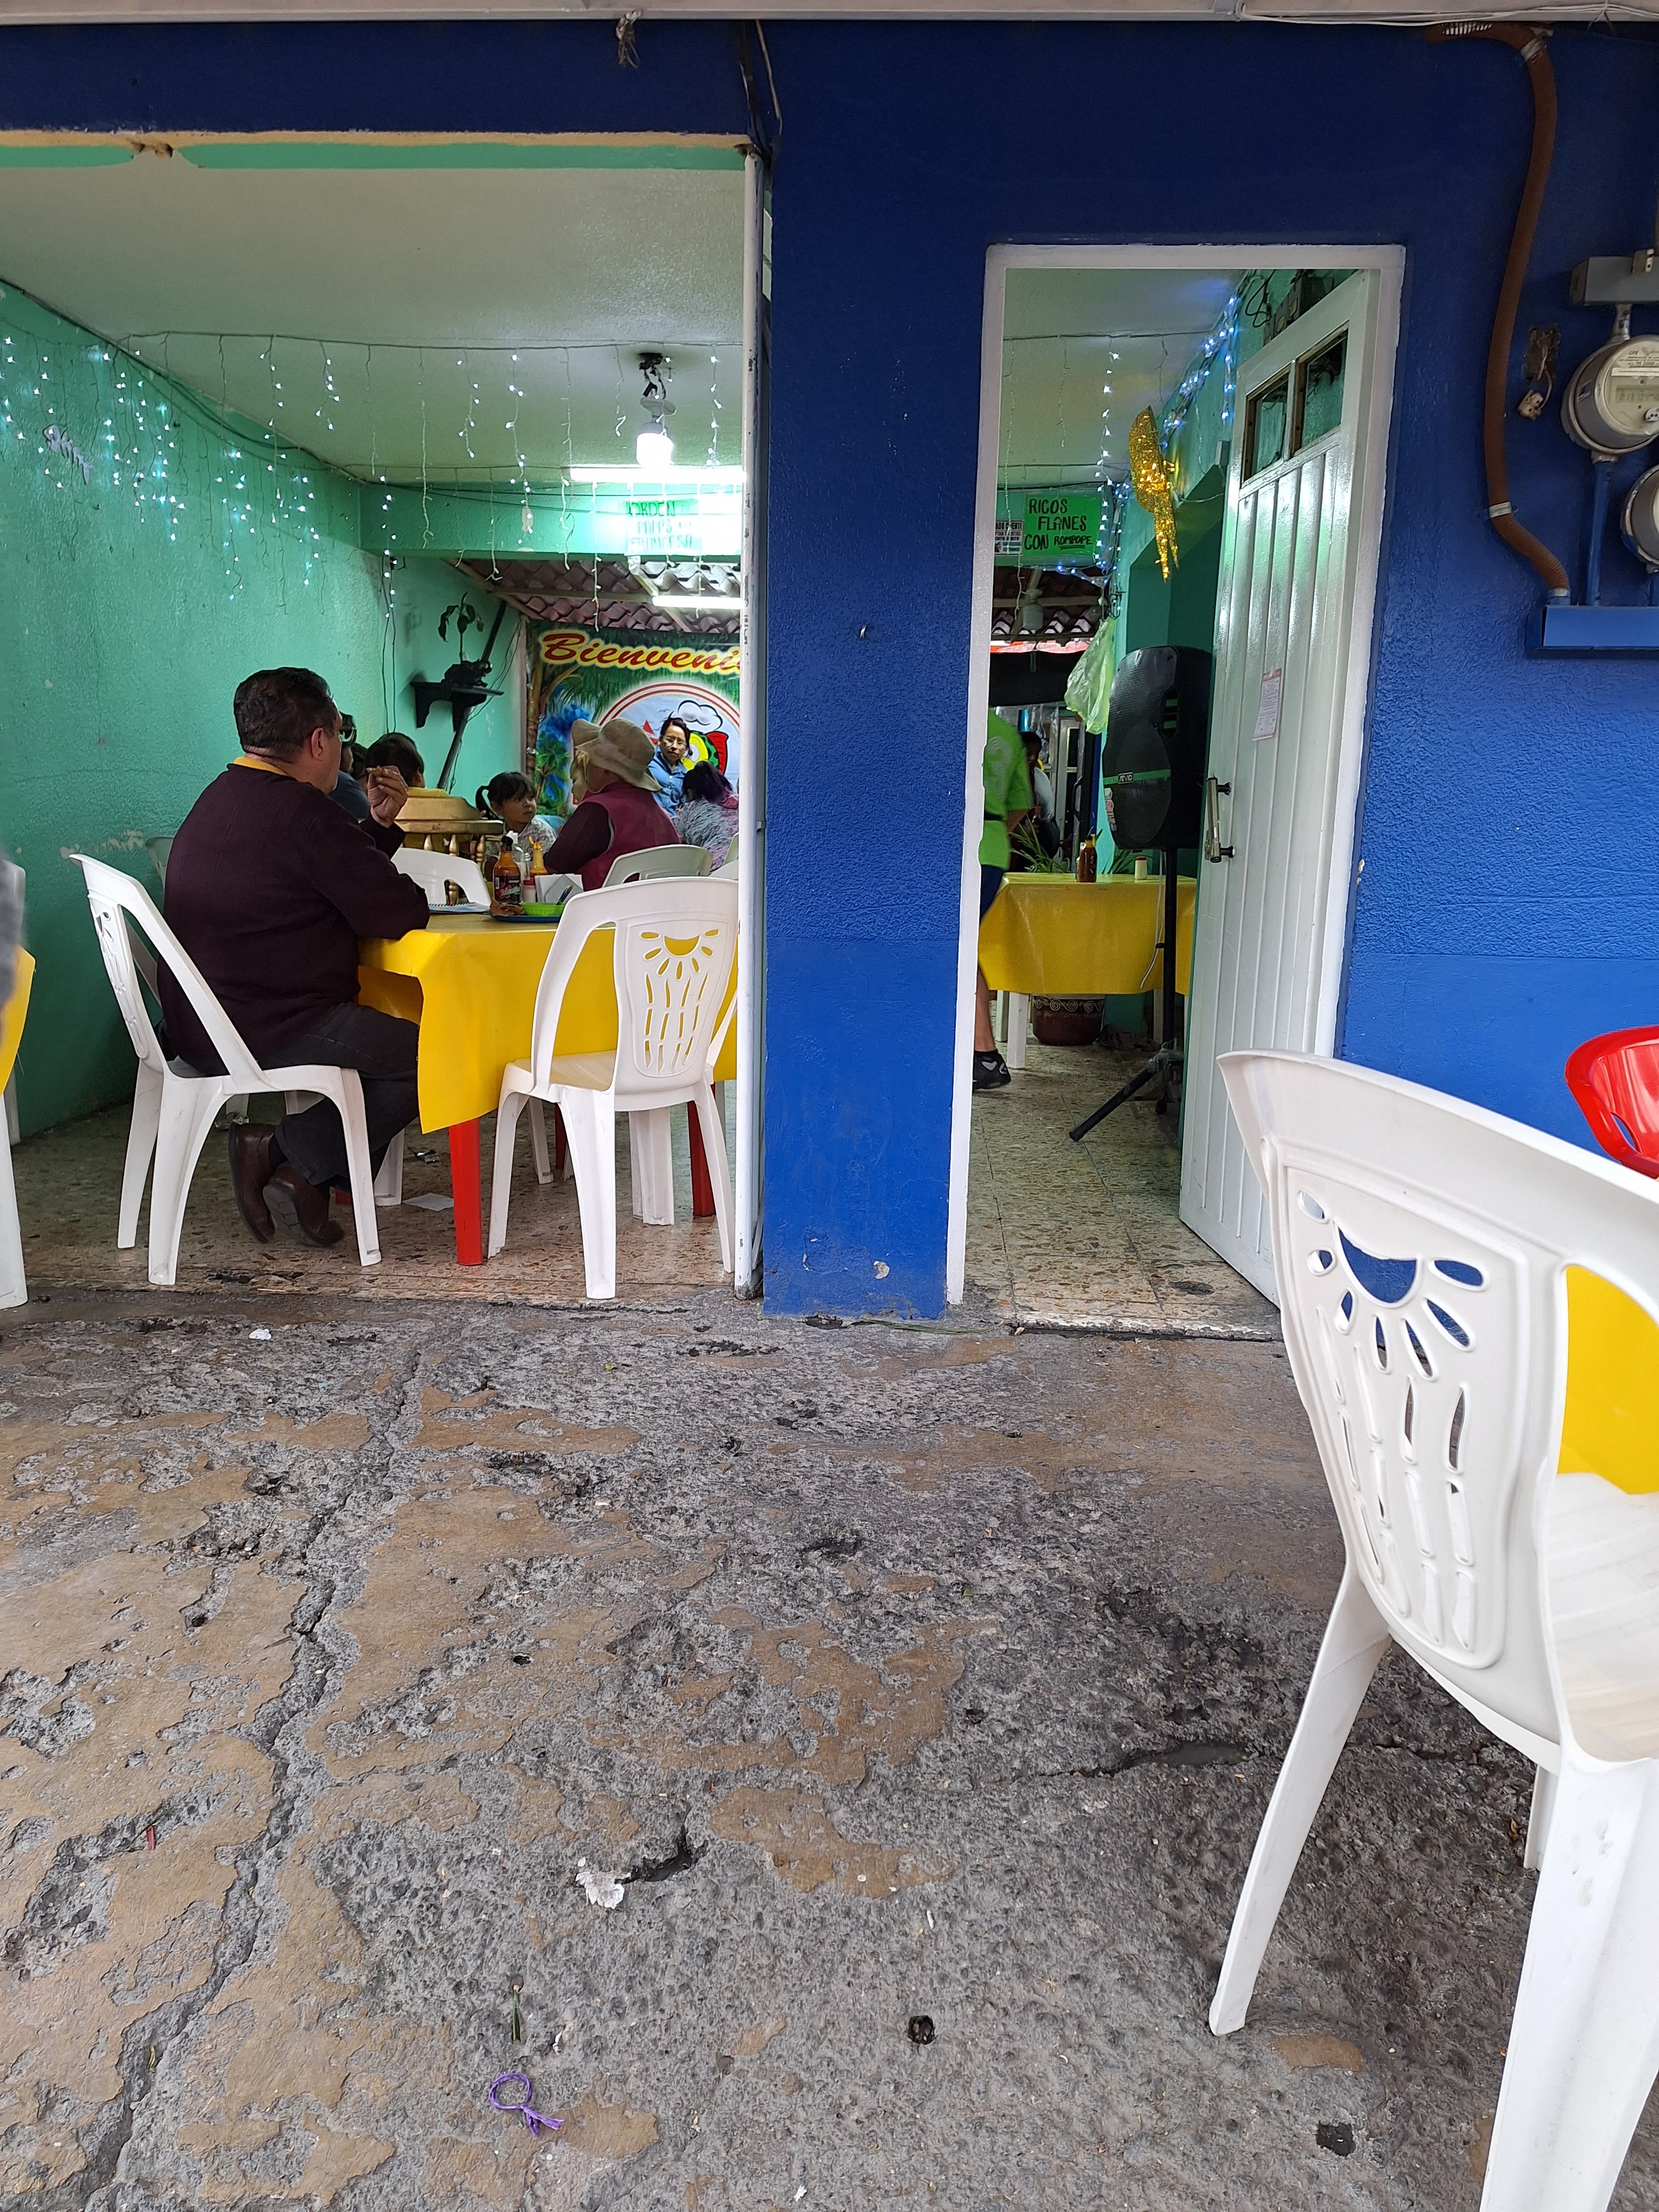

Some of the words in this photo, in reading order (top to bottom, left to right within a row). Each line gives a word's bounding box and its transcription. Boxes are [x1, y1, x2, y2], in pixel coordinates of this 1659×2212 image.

[1029, 499, 1068, 514] RICOS
[1038, 516, 1086, 531] FLANES
[1024, 534, 1049, 550] CON
[1054, 535, 1092, 545] ROMPOPE
[542, 632, 740, 670] Bienveni
